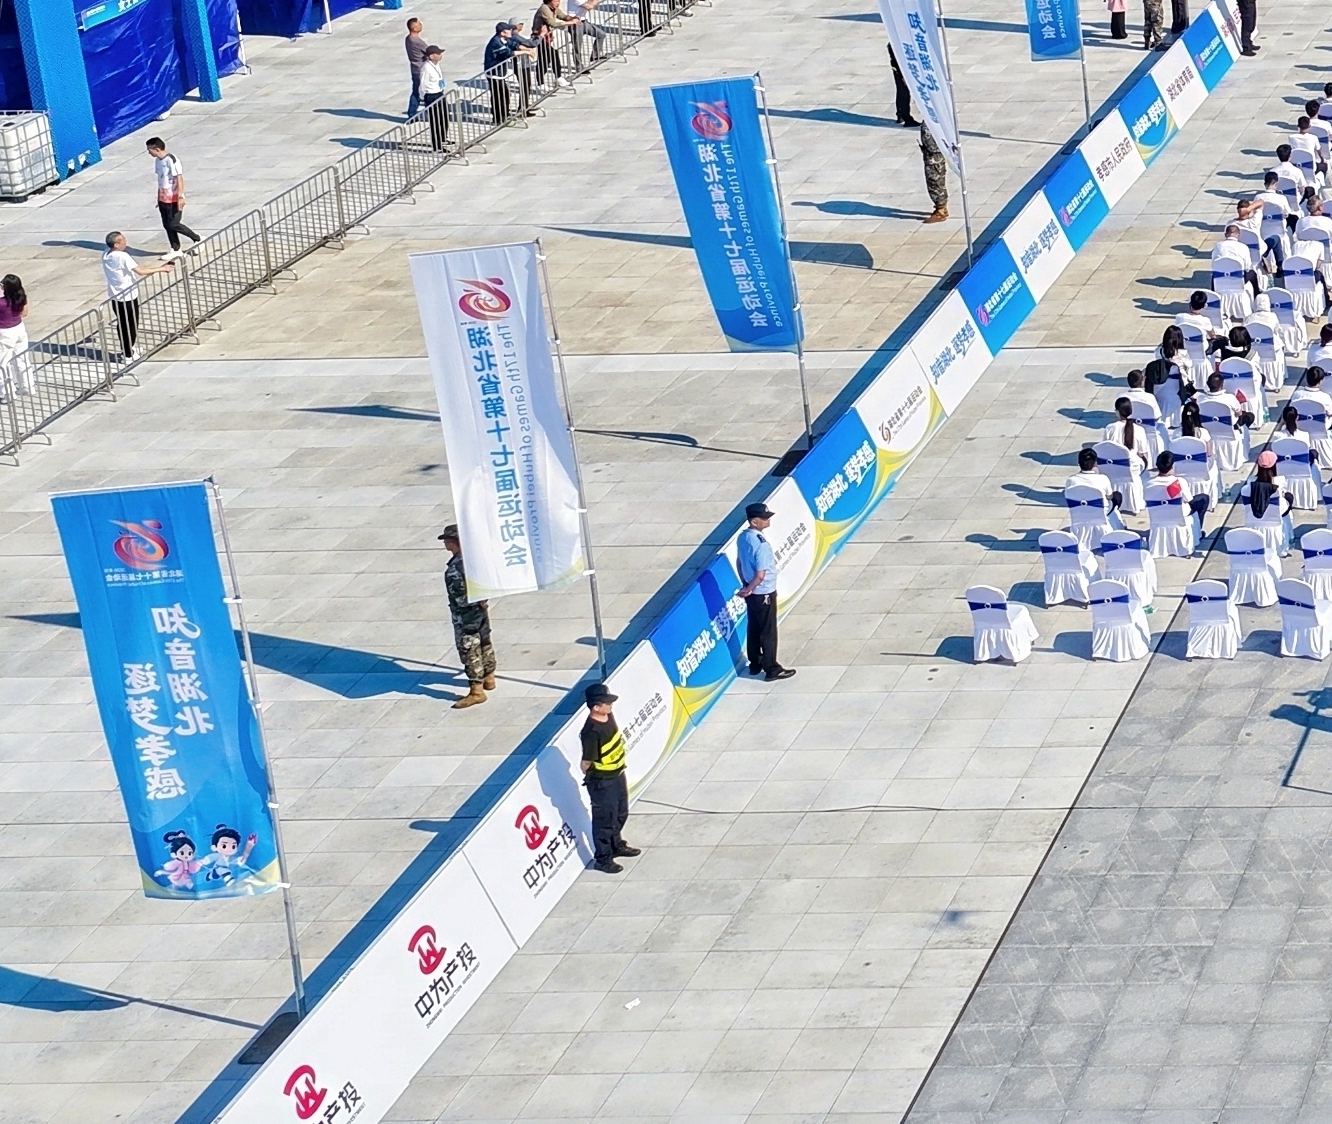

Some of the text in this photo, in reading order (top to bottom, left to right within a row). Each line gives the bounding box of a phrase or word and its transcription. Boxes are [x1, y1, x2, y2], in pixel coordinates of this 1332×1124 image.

[814, 439, 877, 520] 知音湖北 逐梦孝感
[774, 522, 806, 565] 第十七届运动会
[676, 589, 747, 686] 知音湖北 逐梦孝感
[622, 692, 663, 744] 第十七届运动会
[522, 822, 577, 890] 中为产投
[414, 942, 477, 1018] 中为产投
[320, 1080, 362, 1124] 产投
